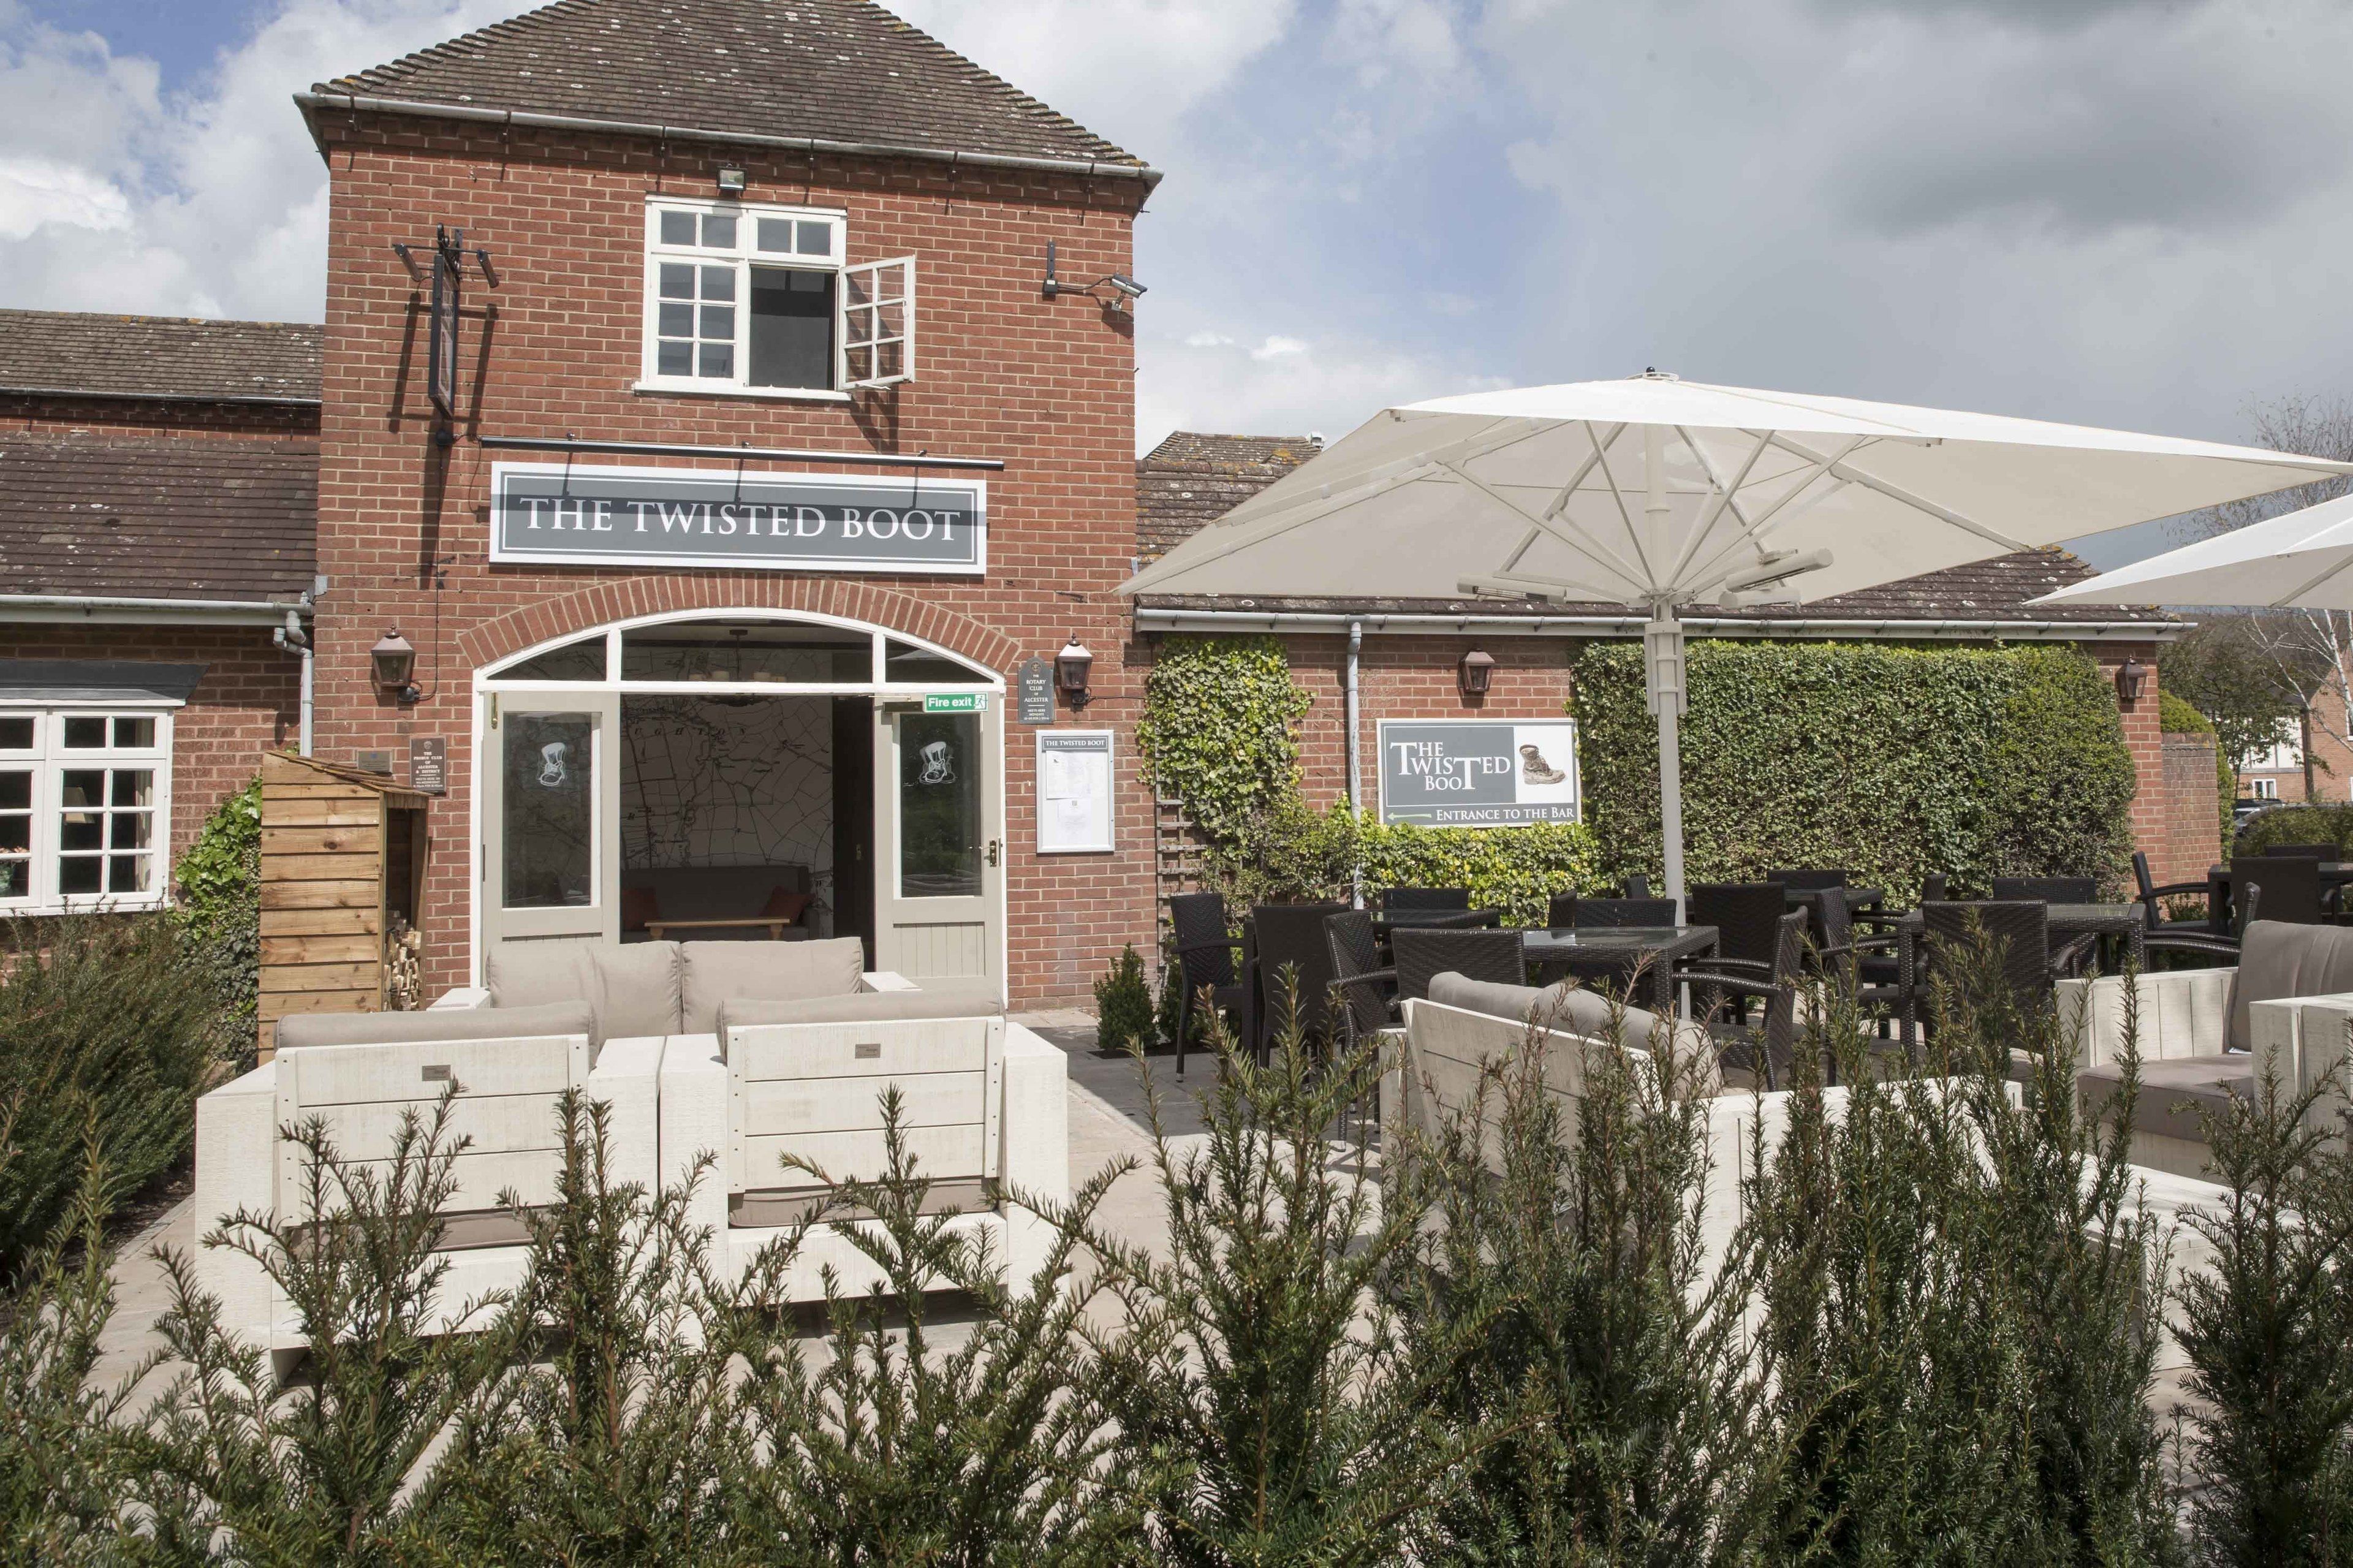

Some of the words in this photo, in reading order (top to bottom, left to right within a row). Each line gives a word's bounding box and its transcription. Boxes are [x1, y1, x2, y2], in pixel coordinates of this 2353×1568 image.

[520, 497, 613, 531] THE
[627, 500, 826, 537] TWISTED
[840, 507, 960, 541] BOOT
[928, 697, 950, 707] Fire
[952, 697, 972, 706] exit
[1390, 741, 1444, 775] THE
[1410, 757, 1510, 790] TWISTED
[1436, 809, 1500, 822] ENTRANCE
[1504, 809, 1520, 819] TO
[1523, 808, 1548, 819] THE
[1551, 806, 1575, 818] BAR
